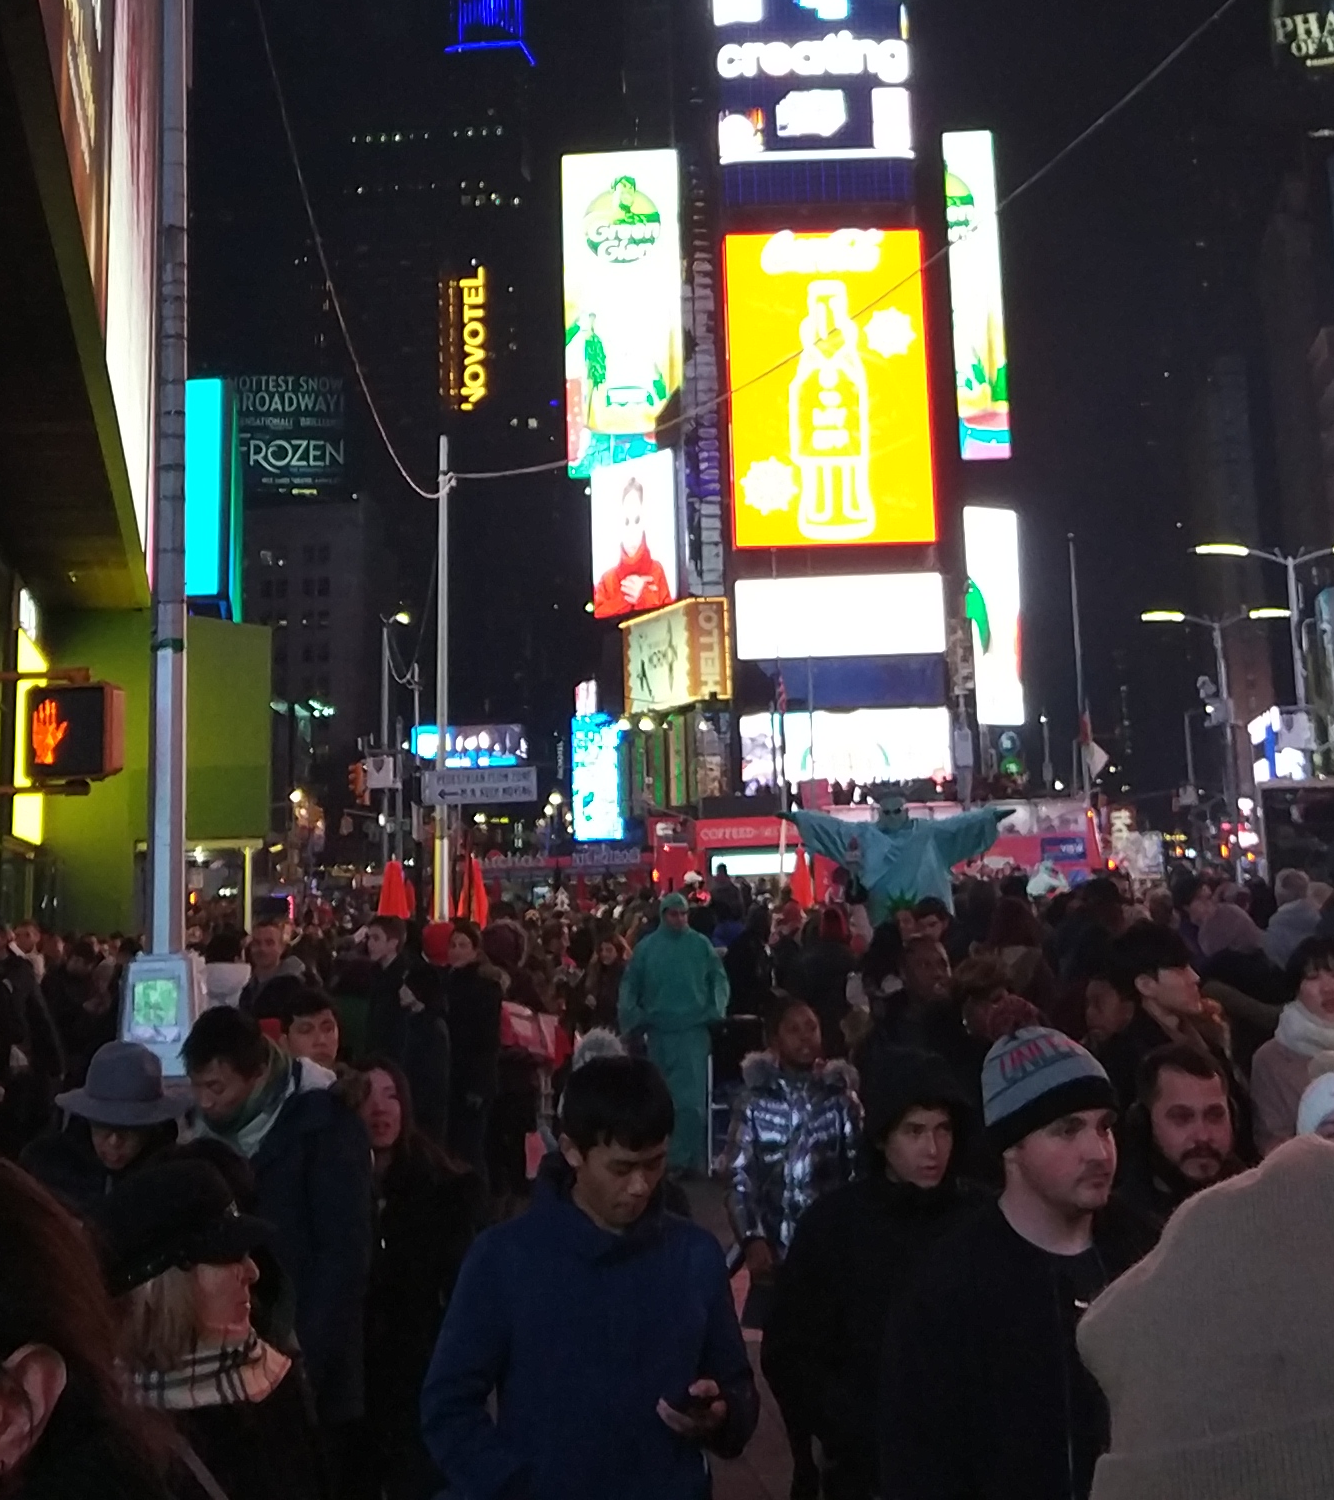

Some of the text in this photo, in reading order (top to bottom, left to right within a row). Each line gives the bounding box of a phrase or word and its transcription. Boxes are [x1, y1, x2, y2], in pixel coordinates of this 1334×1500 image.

[717, 30, 910, 84] creating
[1290, 37, 1319, 57] OF
[458, 265, 487, 412] NOVOTEL
